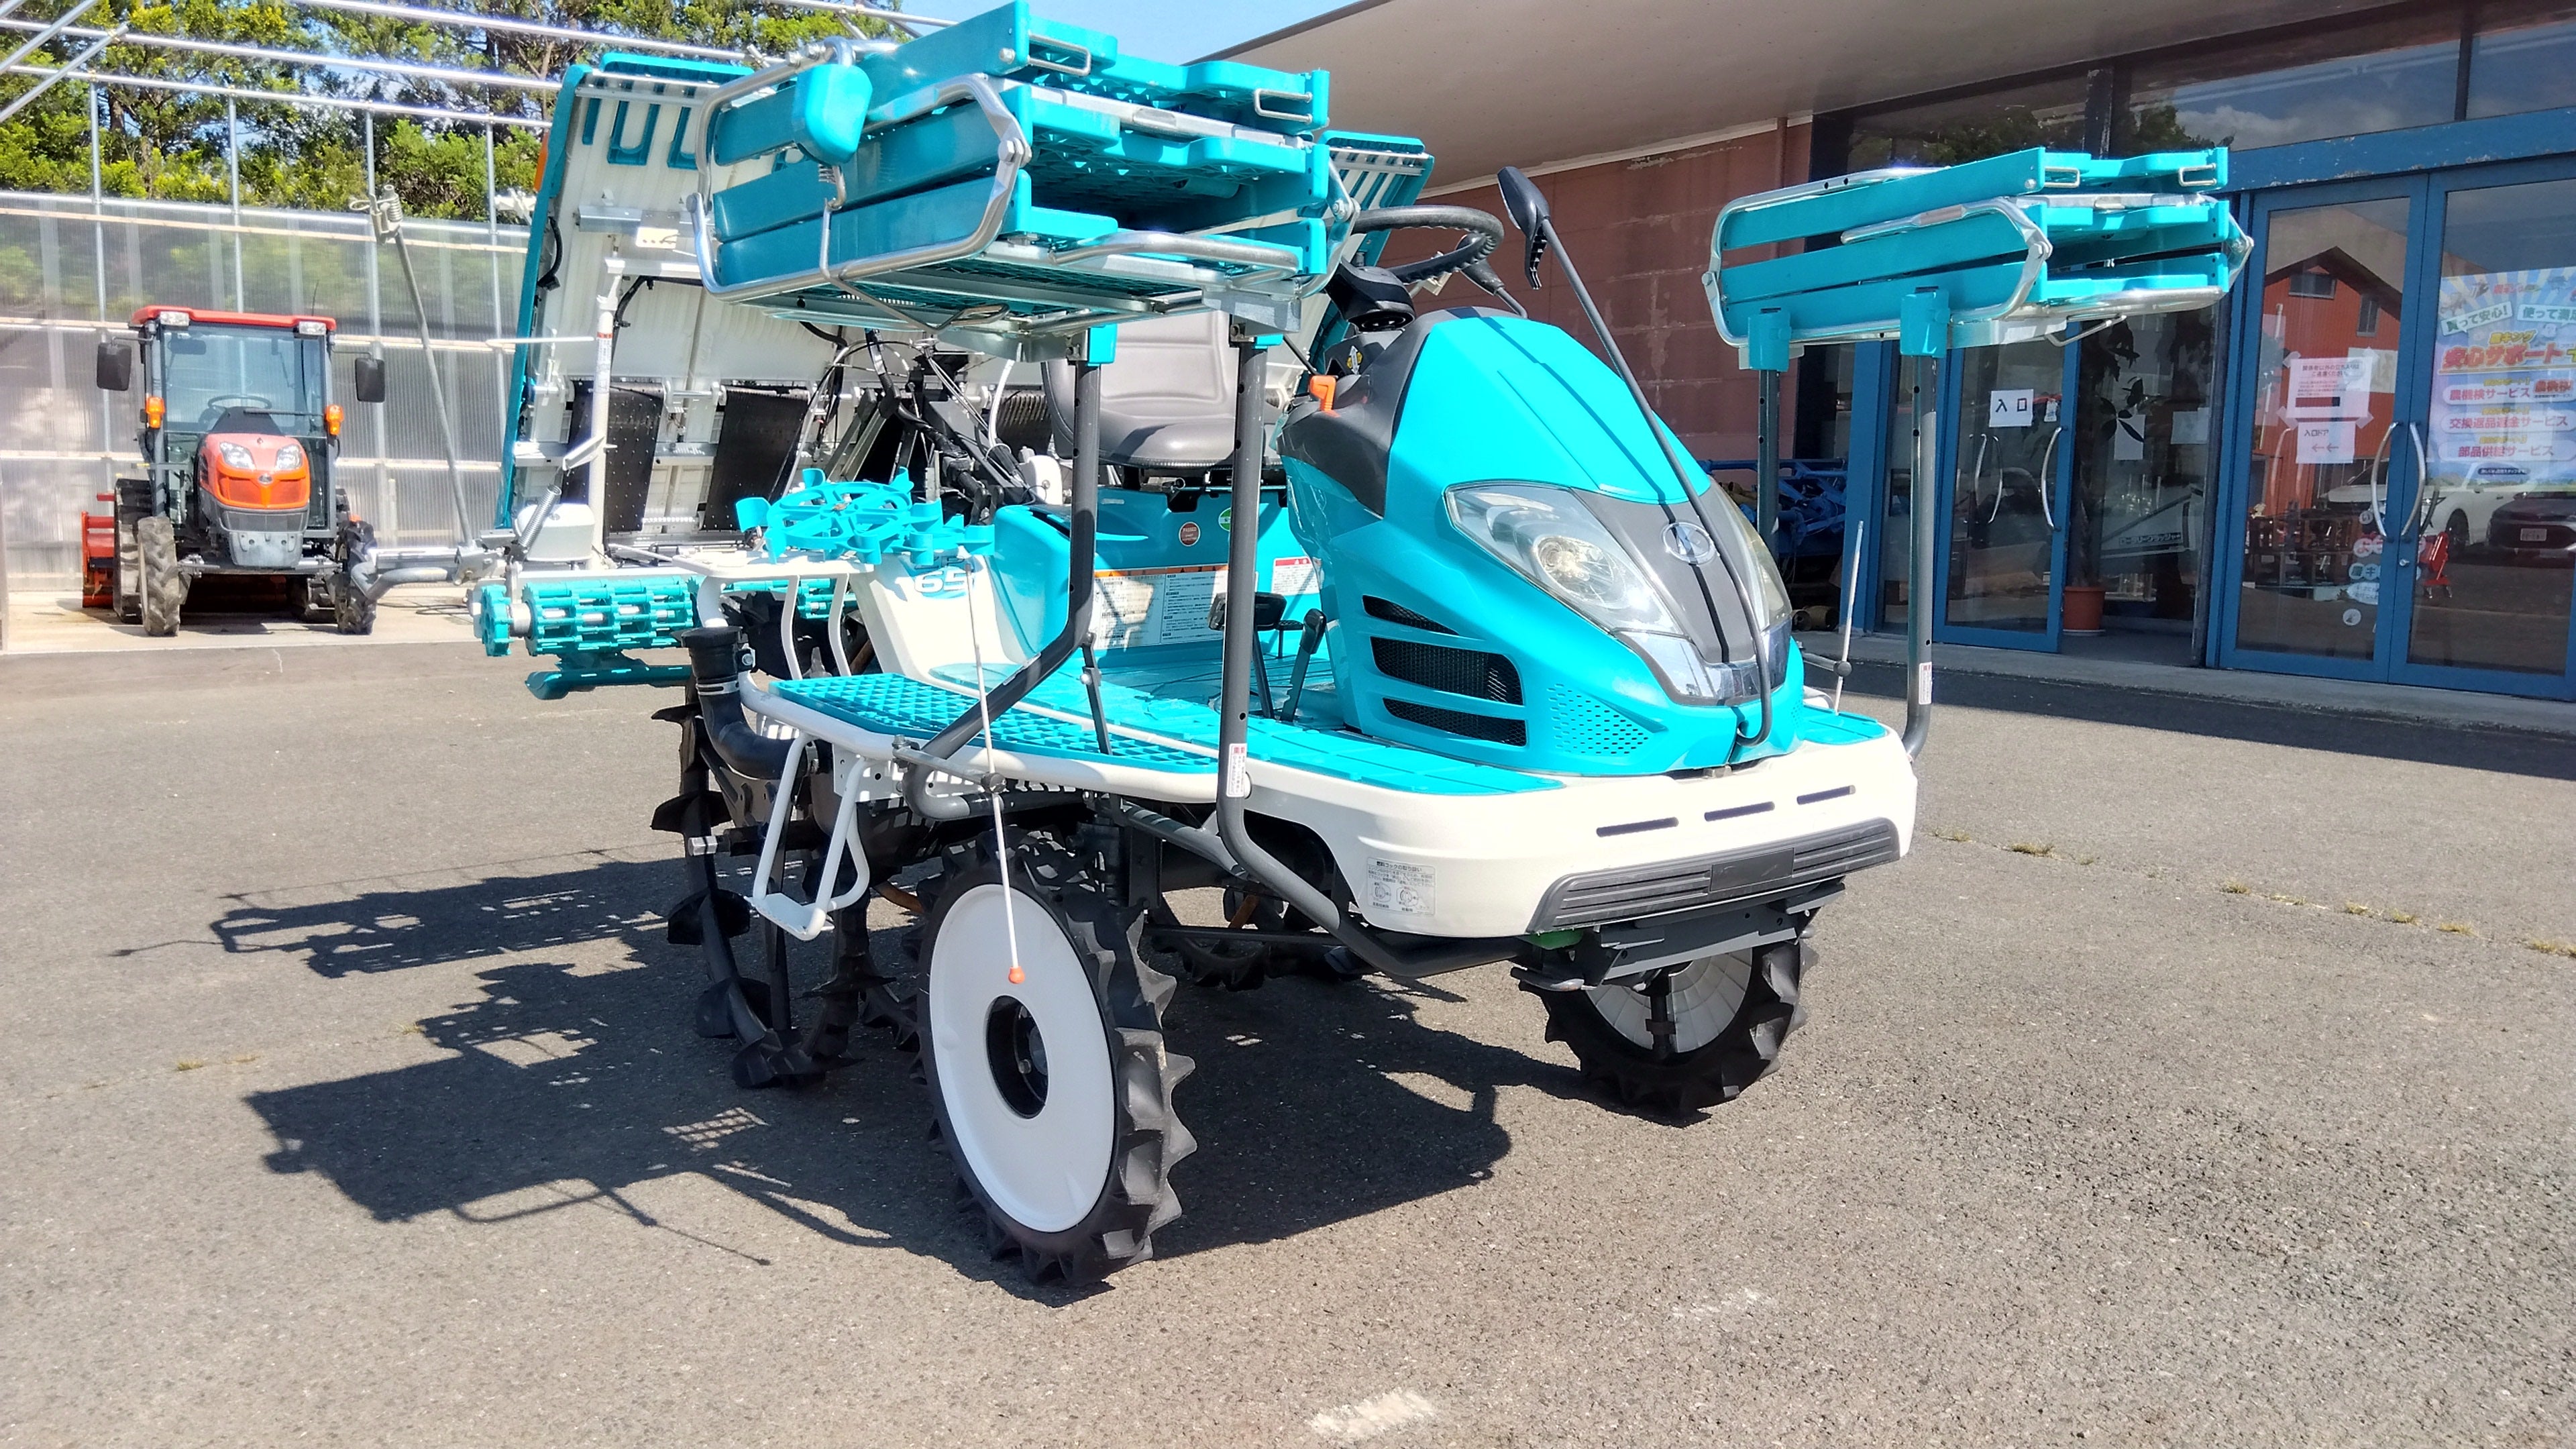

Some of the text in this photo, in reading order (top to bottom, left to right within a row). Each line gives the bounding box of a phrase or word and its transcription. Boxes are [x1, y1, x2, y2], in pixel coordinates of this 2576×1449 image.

[2442, 342, 2564, 370] 安心サポート
[1995, 398, 2027, 413] 入口
